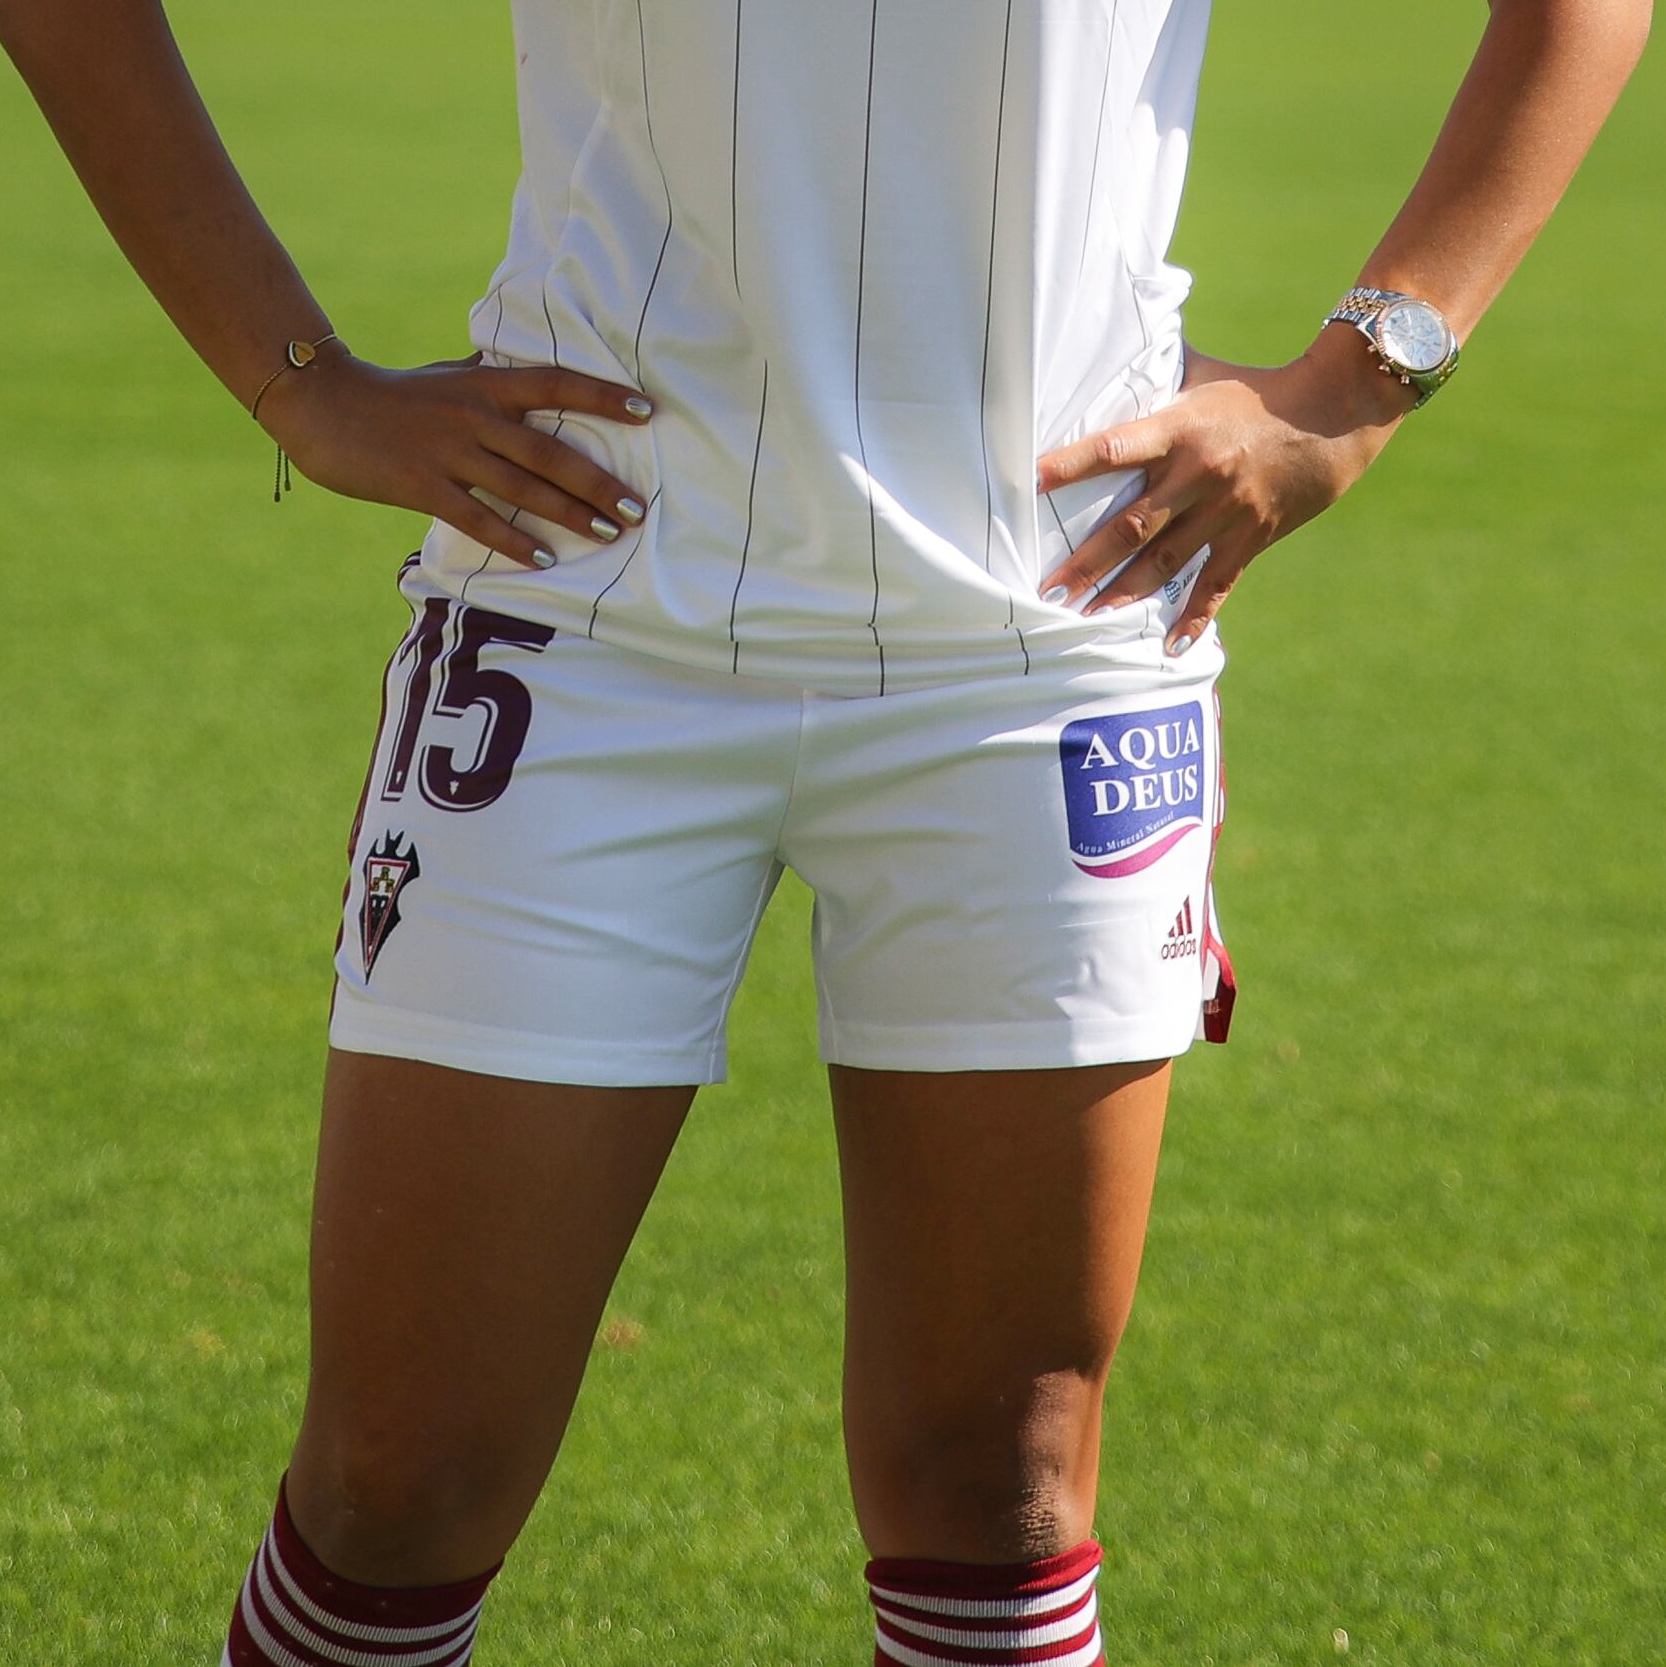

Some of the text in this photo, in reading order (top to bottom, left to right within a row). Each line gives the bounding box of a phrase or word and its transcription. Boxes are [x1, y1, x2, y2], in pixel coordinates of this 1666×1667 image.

[381, 597, 557, 813] 15
[1080, 718, 1200, 771] AQUA
[1090, 764, 1198, 816] DEUS
[1076, 841, 1102, 855] Agua
[1106, 830, 1143, 851] Mineral
[1161, 935, 1196, 960] adidas
